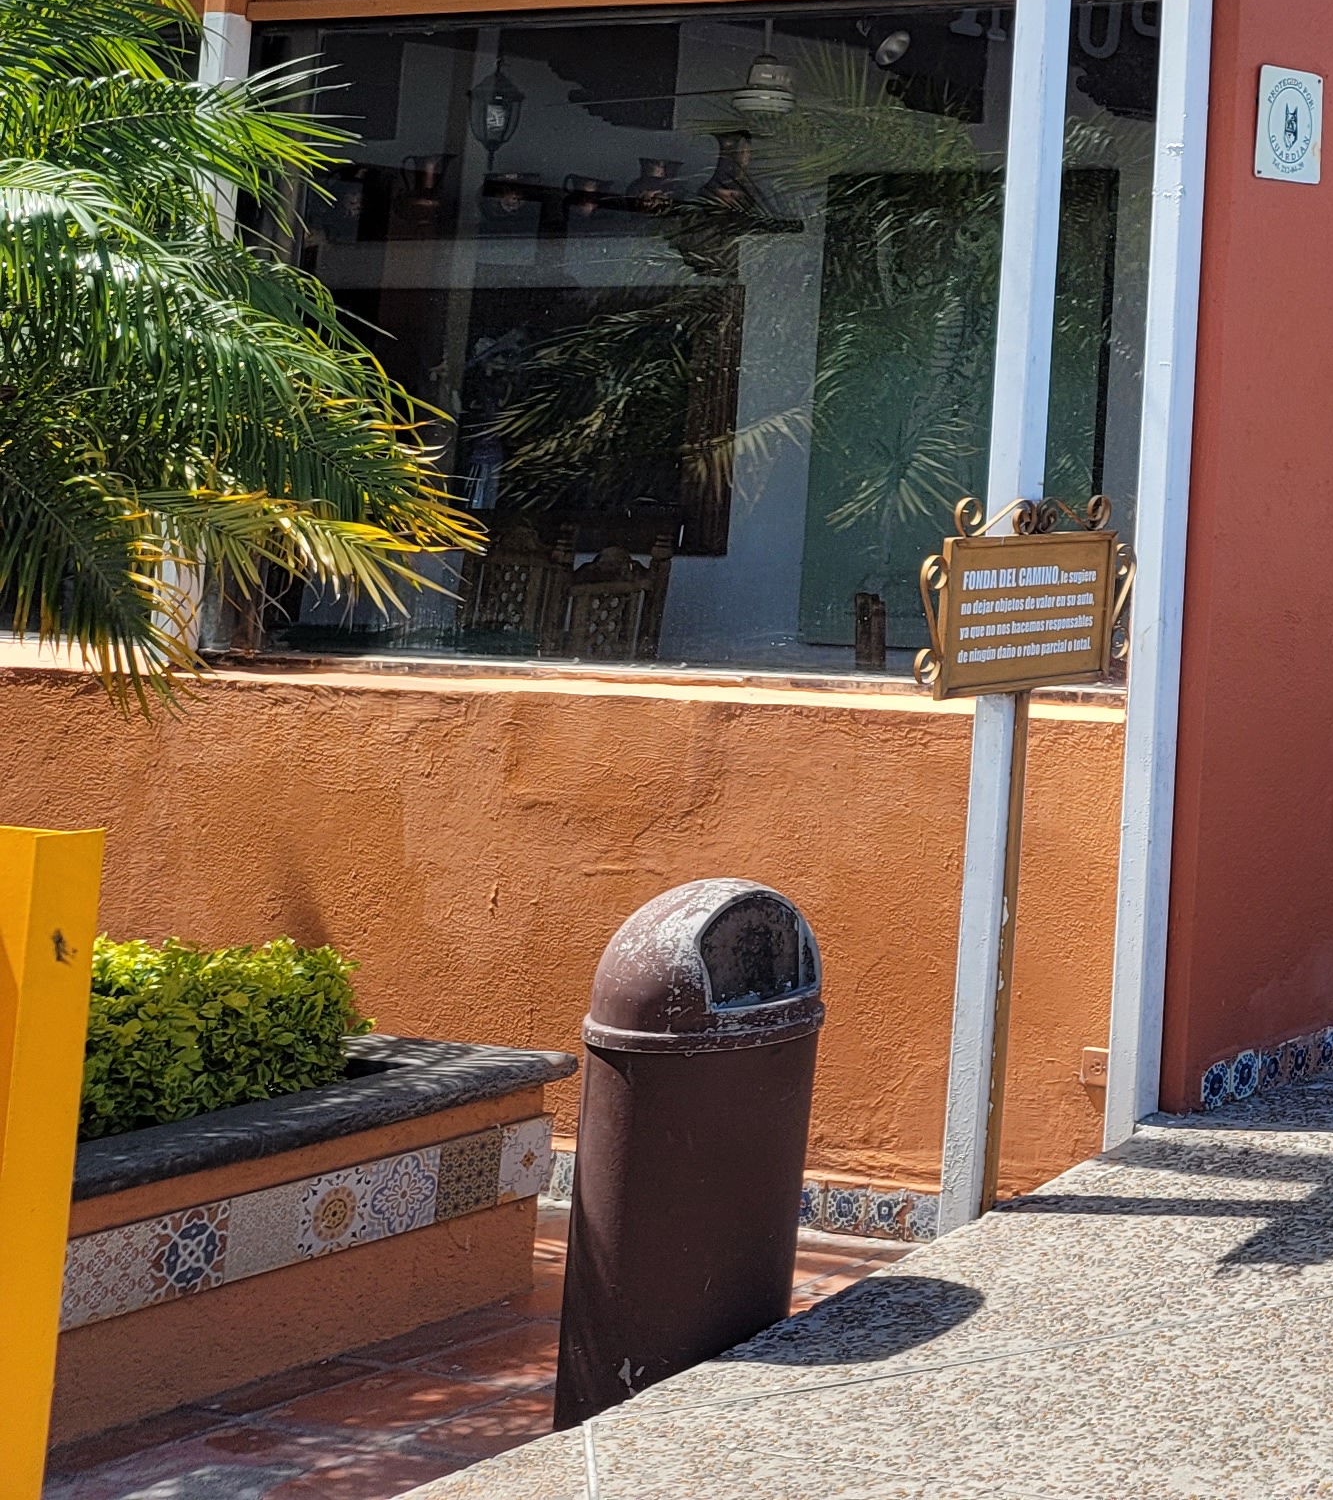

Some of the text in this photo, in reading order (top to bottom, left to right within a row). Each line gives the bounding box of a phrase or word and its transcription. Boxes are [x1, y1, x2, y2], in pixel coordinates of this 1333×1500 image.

[962, 569, 998, 591] FONDA
[999, 568, 1017, 589] DEL
[1018, 565, 1060, 587] CAMINO,
[1068, 569, 1097, 584] sugiere
[960, 602, 972, 615] no
[972, 599, 994, 615] dejar
[995, 597, 1025, 613] objetos
[1025, 596, 1035, 610] de
[1035, 594, 1056, 609] valor
[1056, 595, 1066, 608] en
[1066, 594, 1077, 607] su
[959, 615, 1094, 640] ya que no nos hacemos responsables
[957, 649, 969, 664] de
[996, 643, 1016, 660] daño
[1022, 642, 1041, 657] robo
[1040, 638, 1068, 656] parcial
